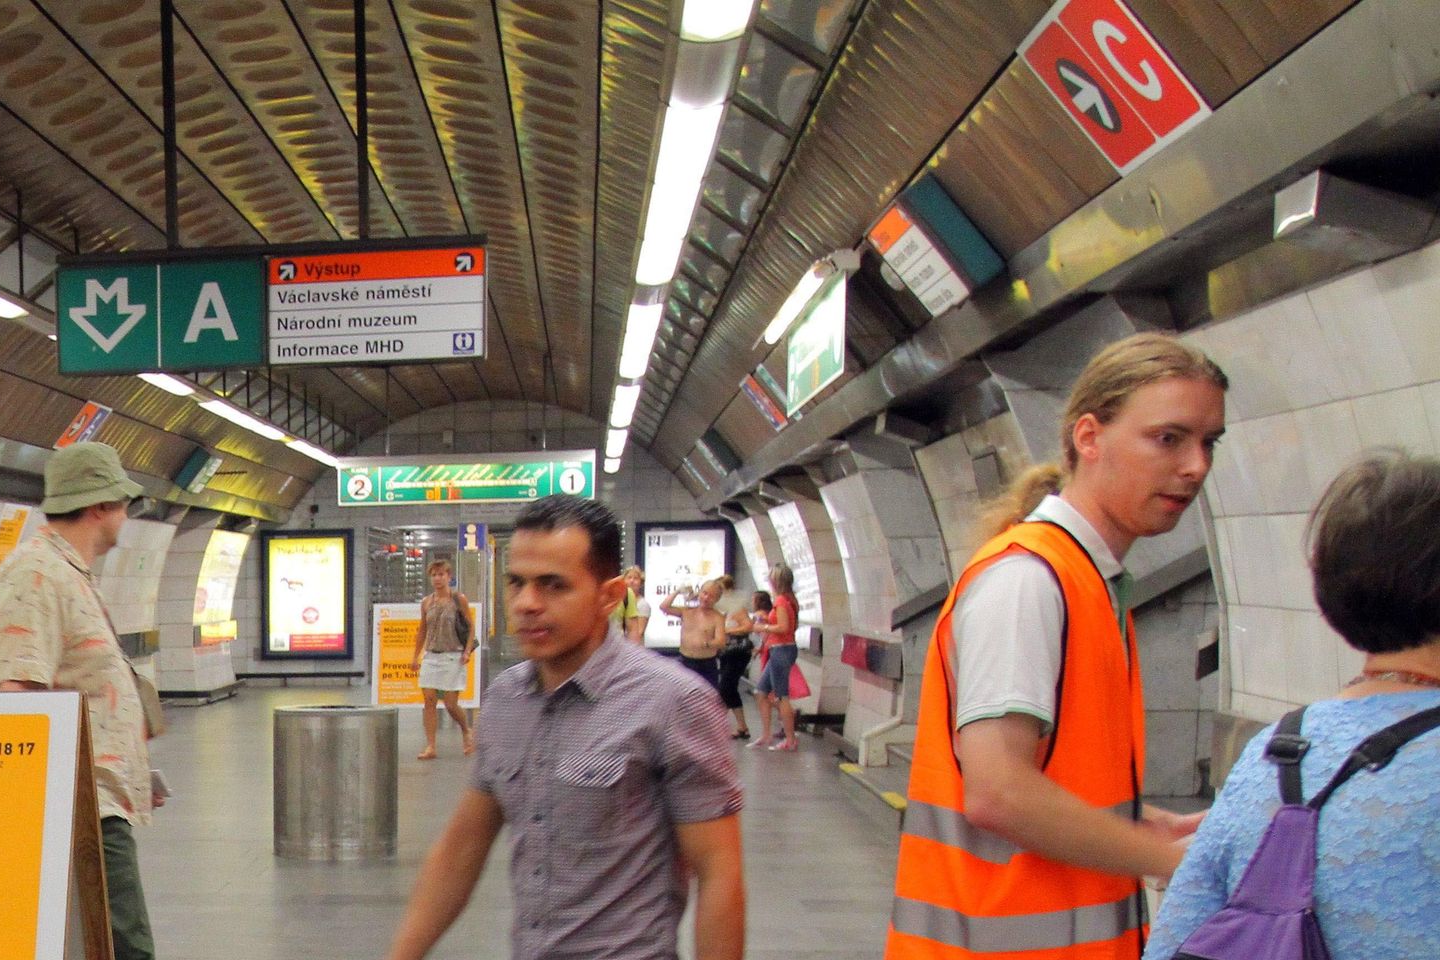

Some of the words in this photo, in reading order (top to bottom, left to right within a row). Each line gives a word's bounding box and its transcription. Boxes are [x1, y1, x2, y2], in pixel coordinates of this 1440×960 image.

[1092, 19, 1163, 101] C
[303, 261, 361, 279] Výstup
[277, 286, 360, 304] Václavské
[366, 283, 432, 300] náměstí
[183, 282, 239, 343] A
[277, 314, 342, 331] Národní
[348, 314, 418, 328] muzeum
[277, 343, 359, 357] Informace
[365, 339, 404, 354] MHD
[354, 479, 365, 496] 2
[568, 474, 575, 491] 1
[18, 742, 36, 755] 17
